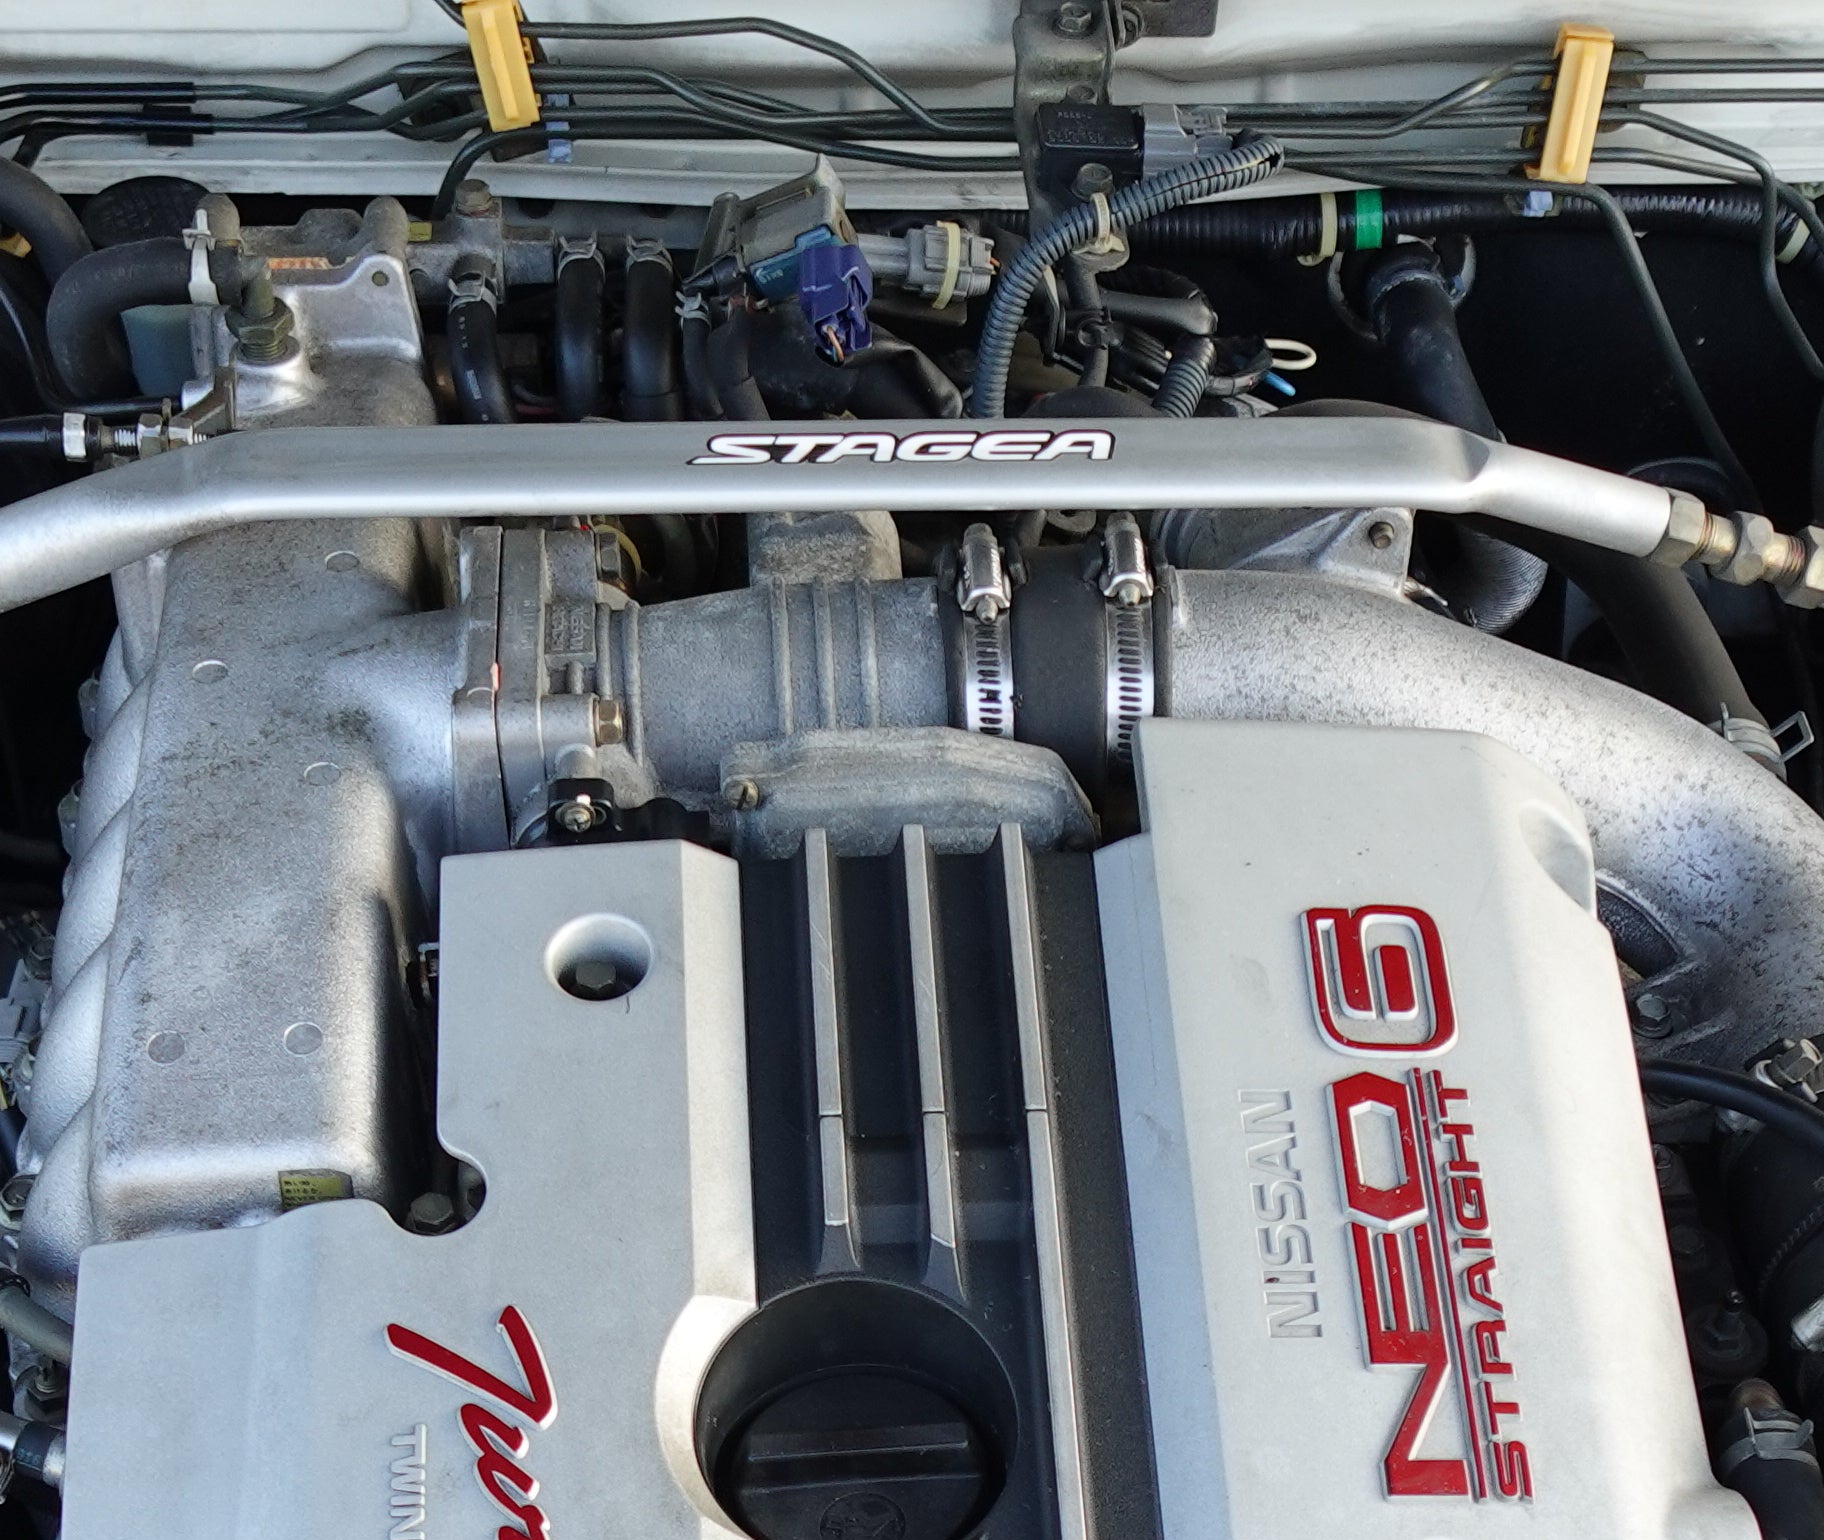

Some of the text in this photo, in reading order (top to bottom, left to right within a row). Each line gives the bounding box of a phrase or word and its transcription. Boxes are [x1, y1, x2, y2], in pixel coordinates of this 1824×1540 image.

[687, 430, 1115, 465] STAGEA
[1237, 1088, 1325, 1341] NISSAN
[1300, 903, 1474, 1503] NEO 6
[1435, 1080, 1537, 1503] STRAIGHT
